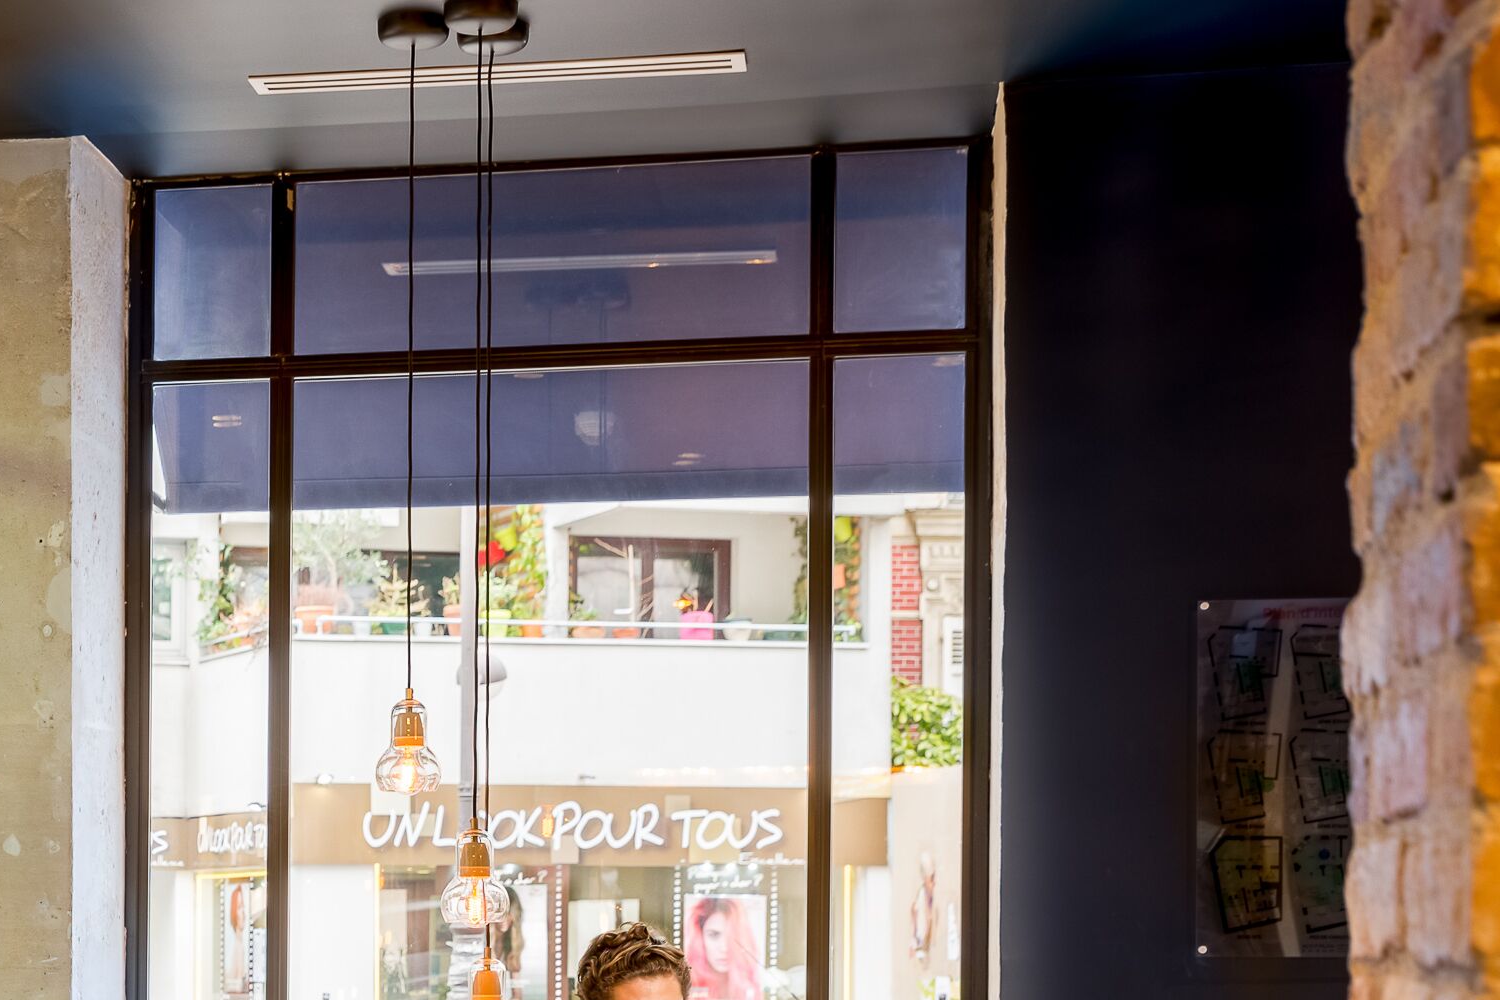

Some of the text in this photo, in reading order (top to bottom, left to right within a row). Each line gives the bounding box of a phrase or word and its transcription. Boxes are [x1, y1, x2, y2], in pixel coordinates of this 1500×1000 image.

[362, 801, 784, 850] UN LOK POUR TOUS
